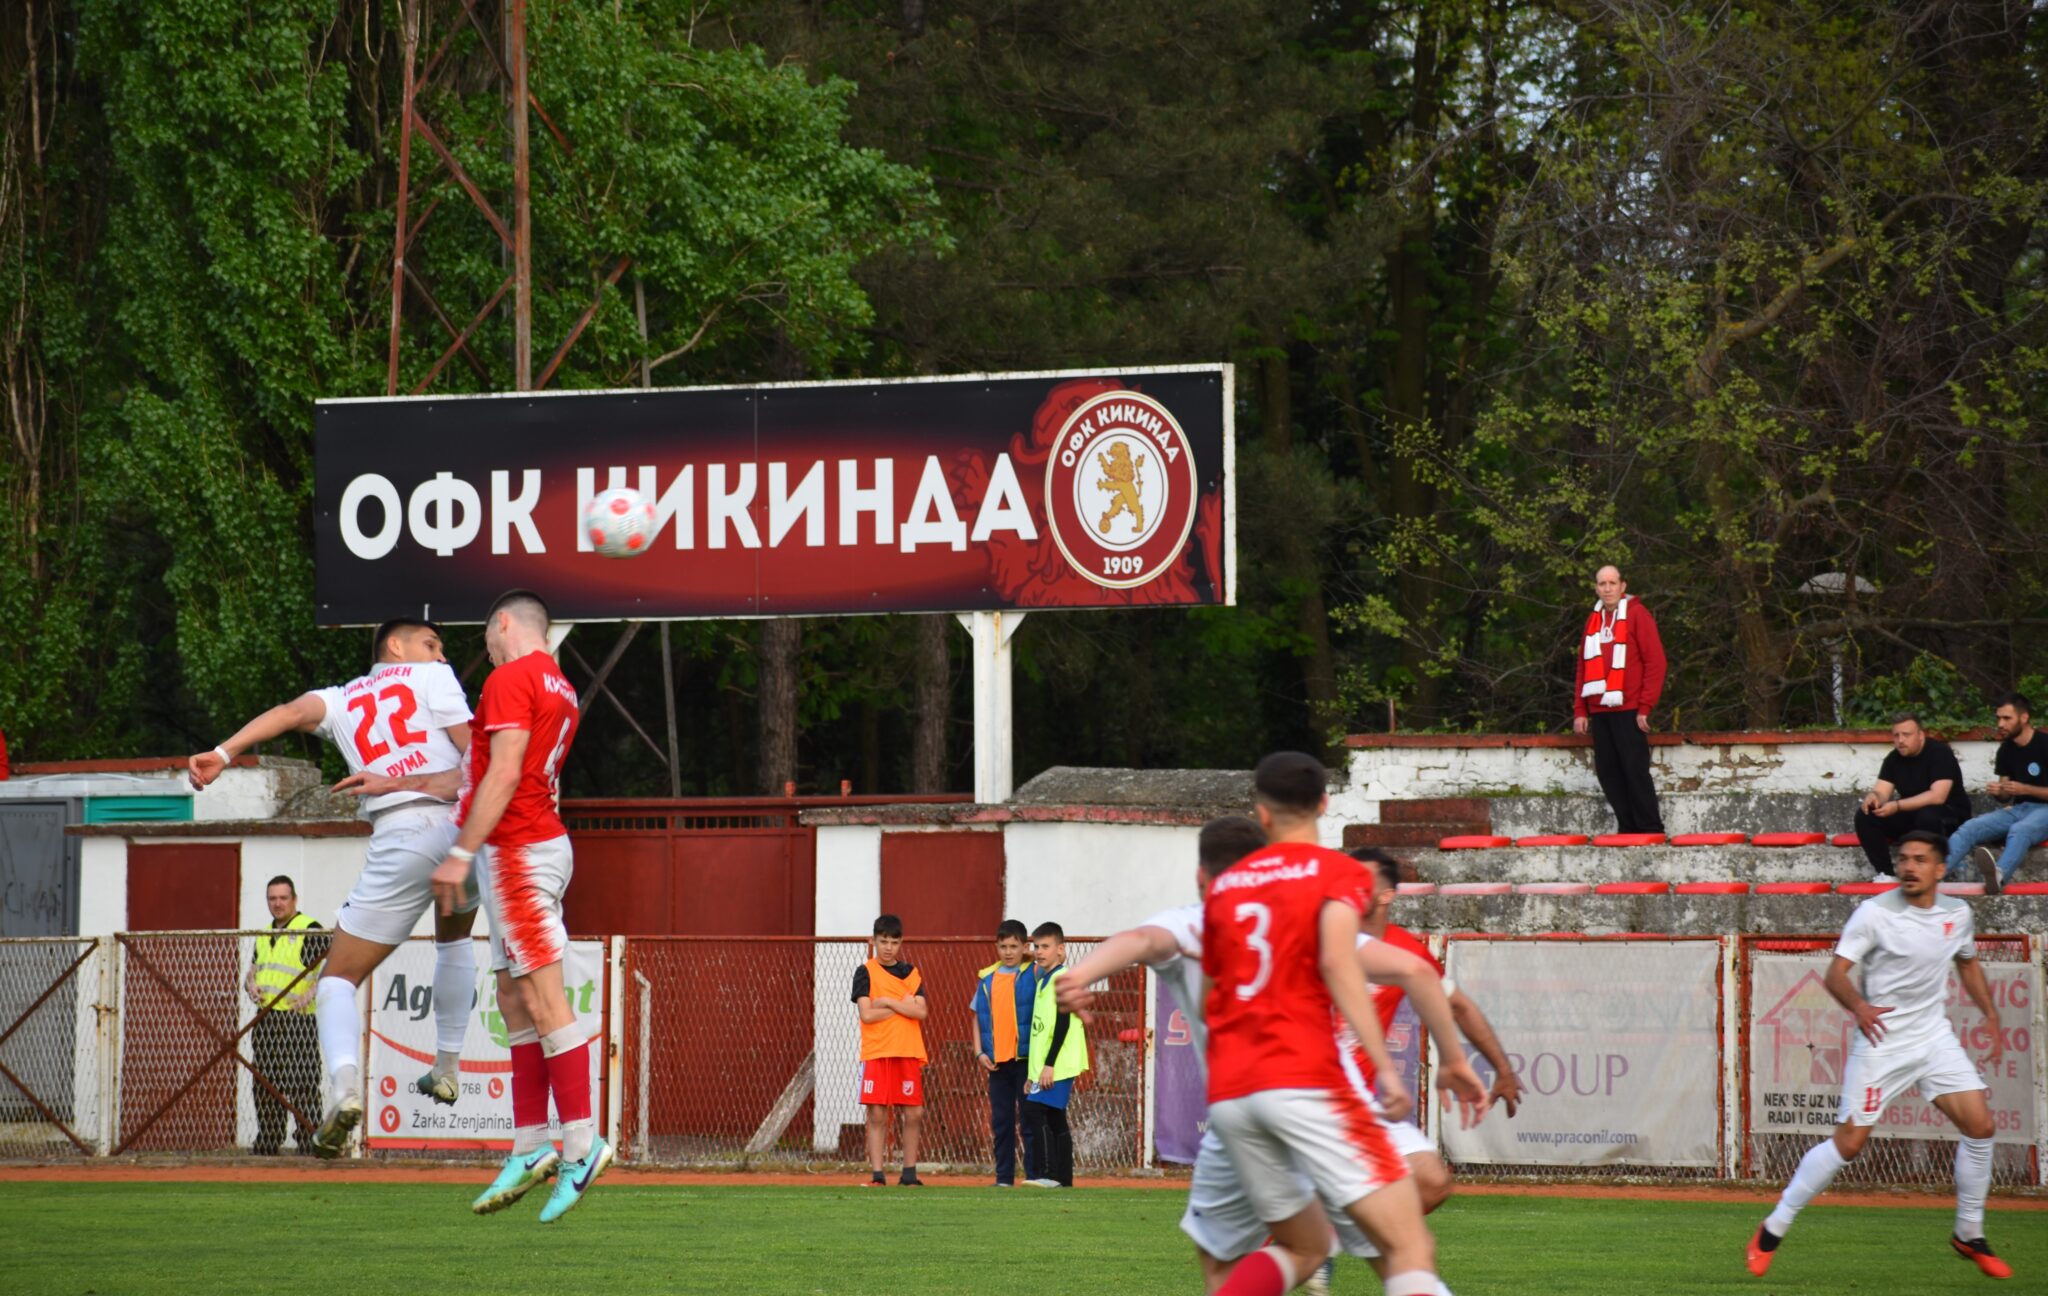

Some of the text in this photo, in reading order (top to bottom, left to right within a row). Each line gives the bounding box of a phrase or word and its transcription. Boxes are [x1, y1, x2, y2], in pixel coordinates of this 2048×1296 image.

[1061, 404, 1180, 468] ОФК КИКИНДА
[338, 468, 546, 560] ОФК
[1103, 556, 1143, 575] 1909
[348, 683, 428, 766] 22
[502, 937, 517, 964] 4
[1234, 902, 1273, 1000] 3
[462, 1083, 481, 1095] 768
[864, 1080, 874, 1094] 10
[1793, 1094, 1806, 1107] SE
[1809, 1095, 1824, 1108] UZ
[1828, 1095, 1842, 1108] NA
[412, 1109, 512, 1133] Žarka Zrenjanina
[1768, 1111, 1795, 1124] RADI
[1807, 1112, 1839, 1126] GRAD
[1517, 1130, 1638, 1147] www.praconil.com
